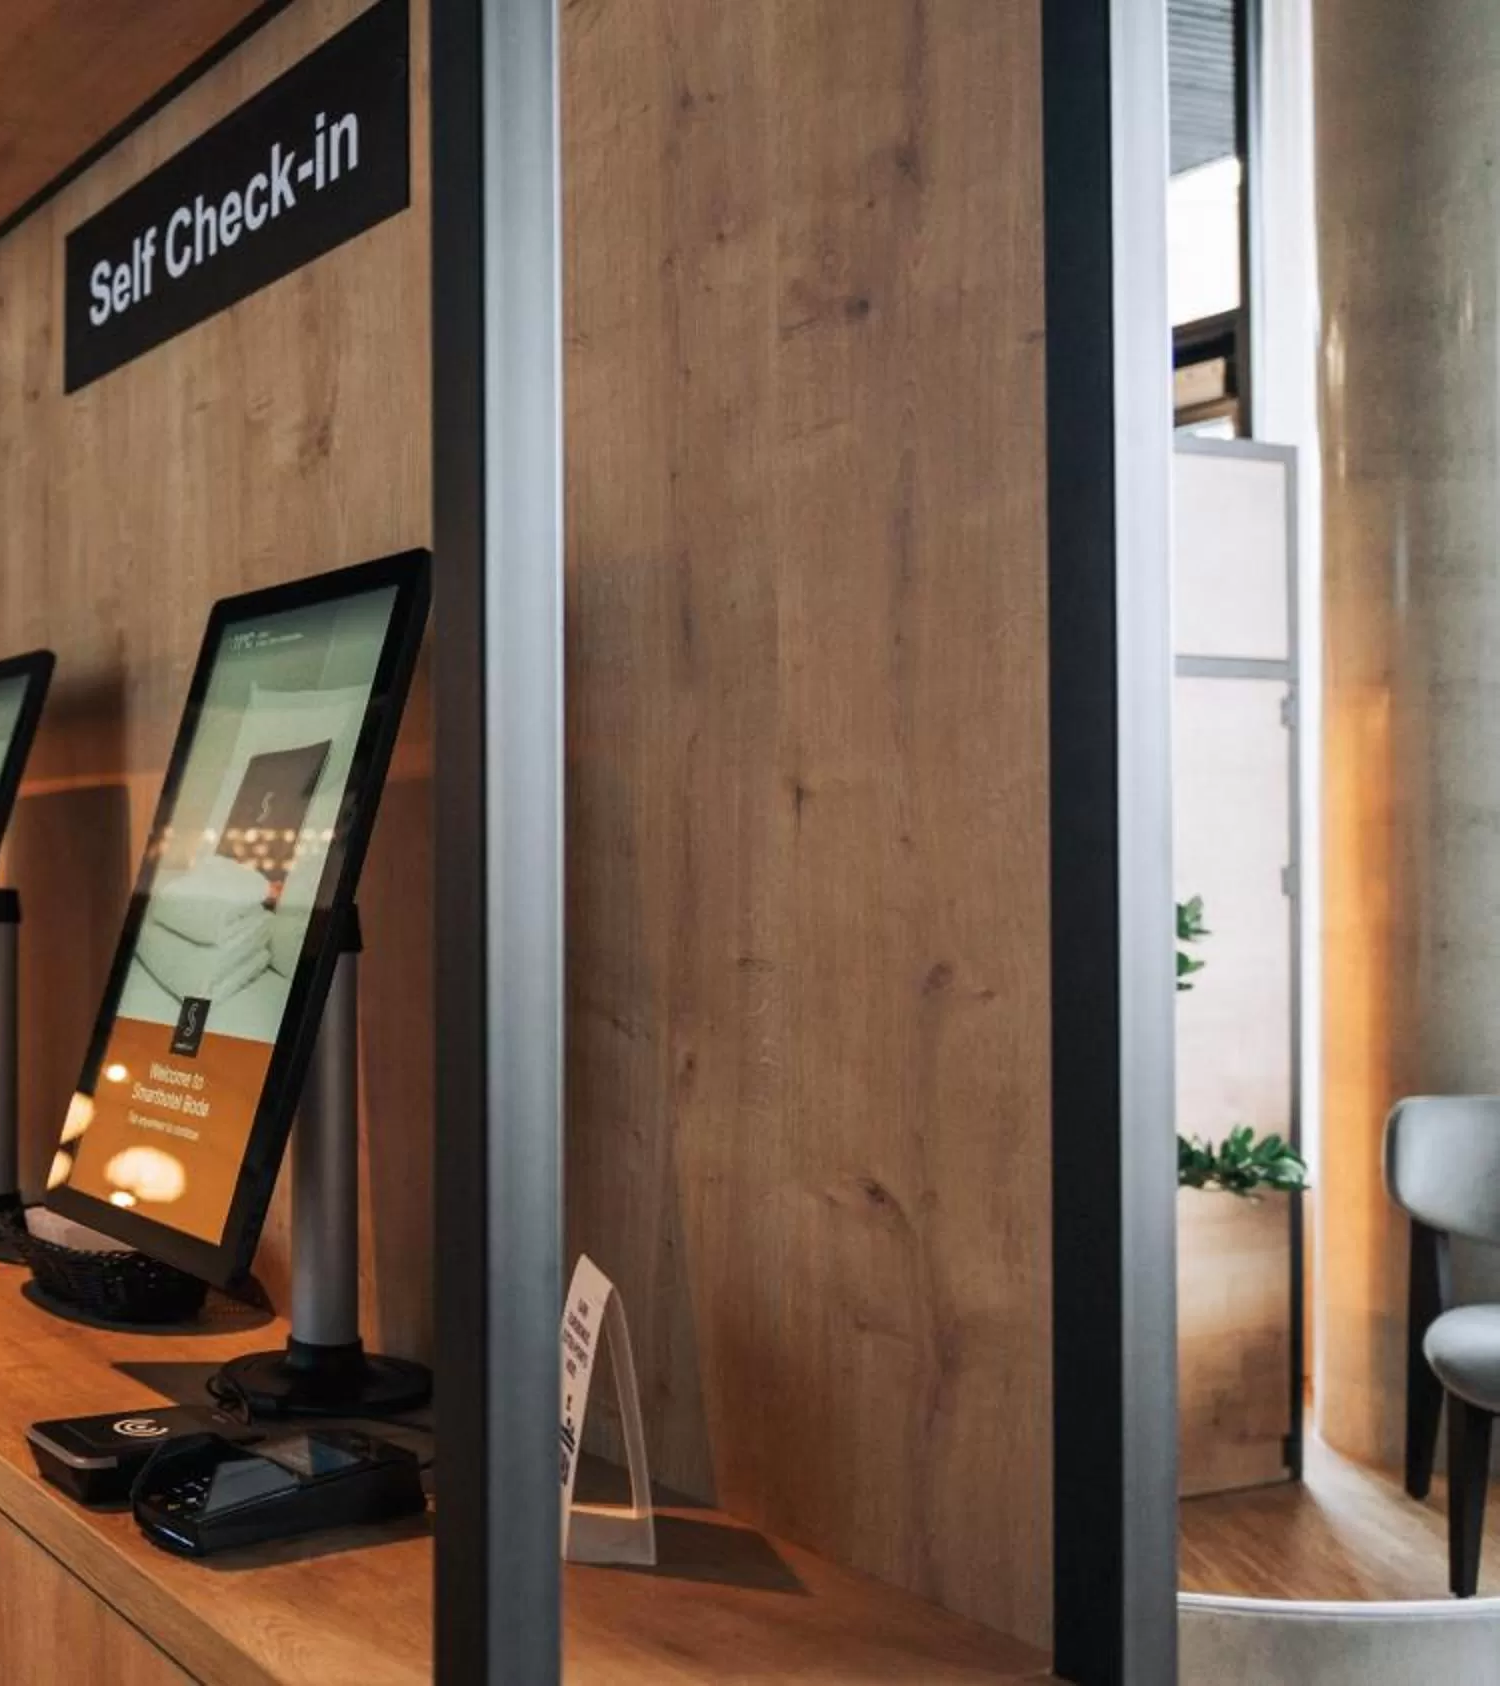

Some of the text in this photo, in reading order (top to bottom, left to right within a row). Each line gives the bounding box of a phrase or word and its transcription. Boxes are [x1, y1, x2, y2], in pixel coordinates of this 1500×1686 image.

[89, 112, 359, 326] Self Check-in
[150, 1062, 204, 1090] Welcome to
